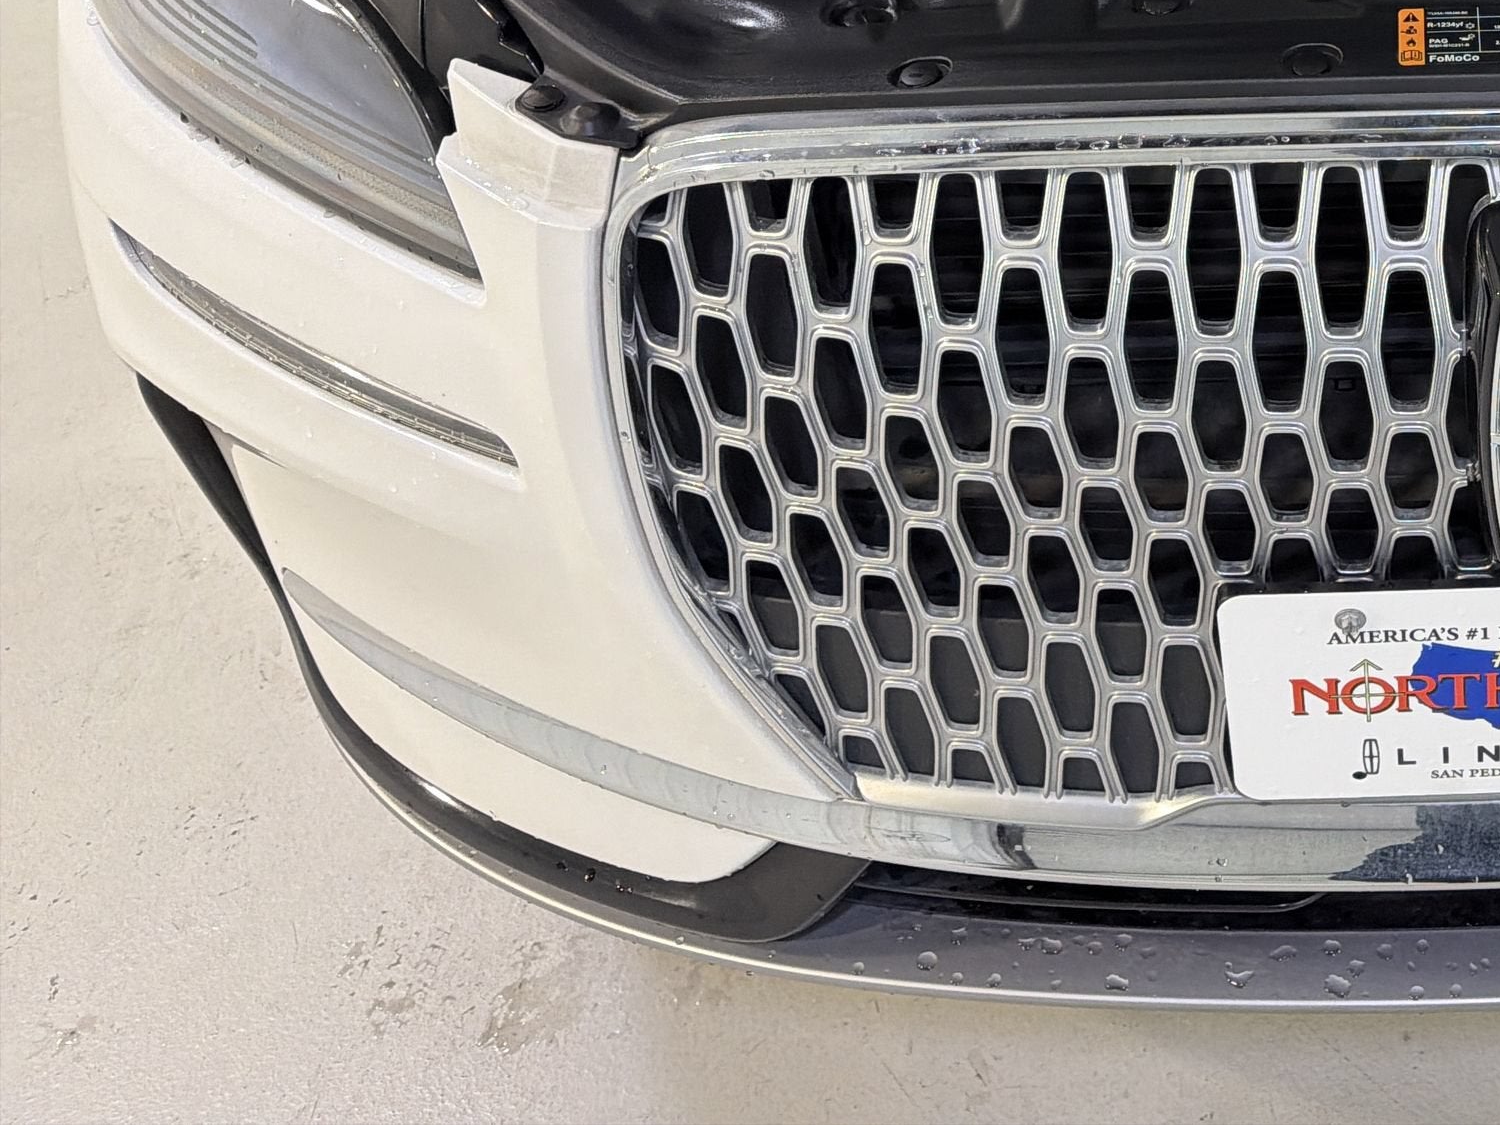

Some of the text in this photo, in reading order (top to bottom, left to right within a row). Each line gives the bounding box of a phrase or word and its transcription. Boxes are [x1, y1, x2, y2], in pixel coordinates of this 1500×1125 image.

[1429, 54, 1480, 63] FoMoCo
[1327, 627, 1459, 645] AMERICA'S
[1466, 627, 1491, 641] #1
[1430, 769, 1464, 779] SAN
